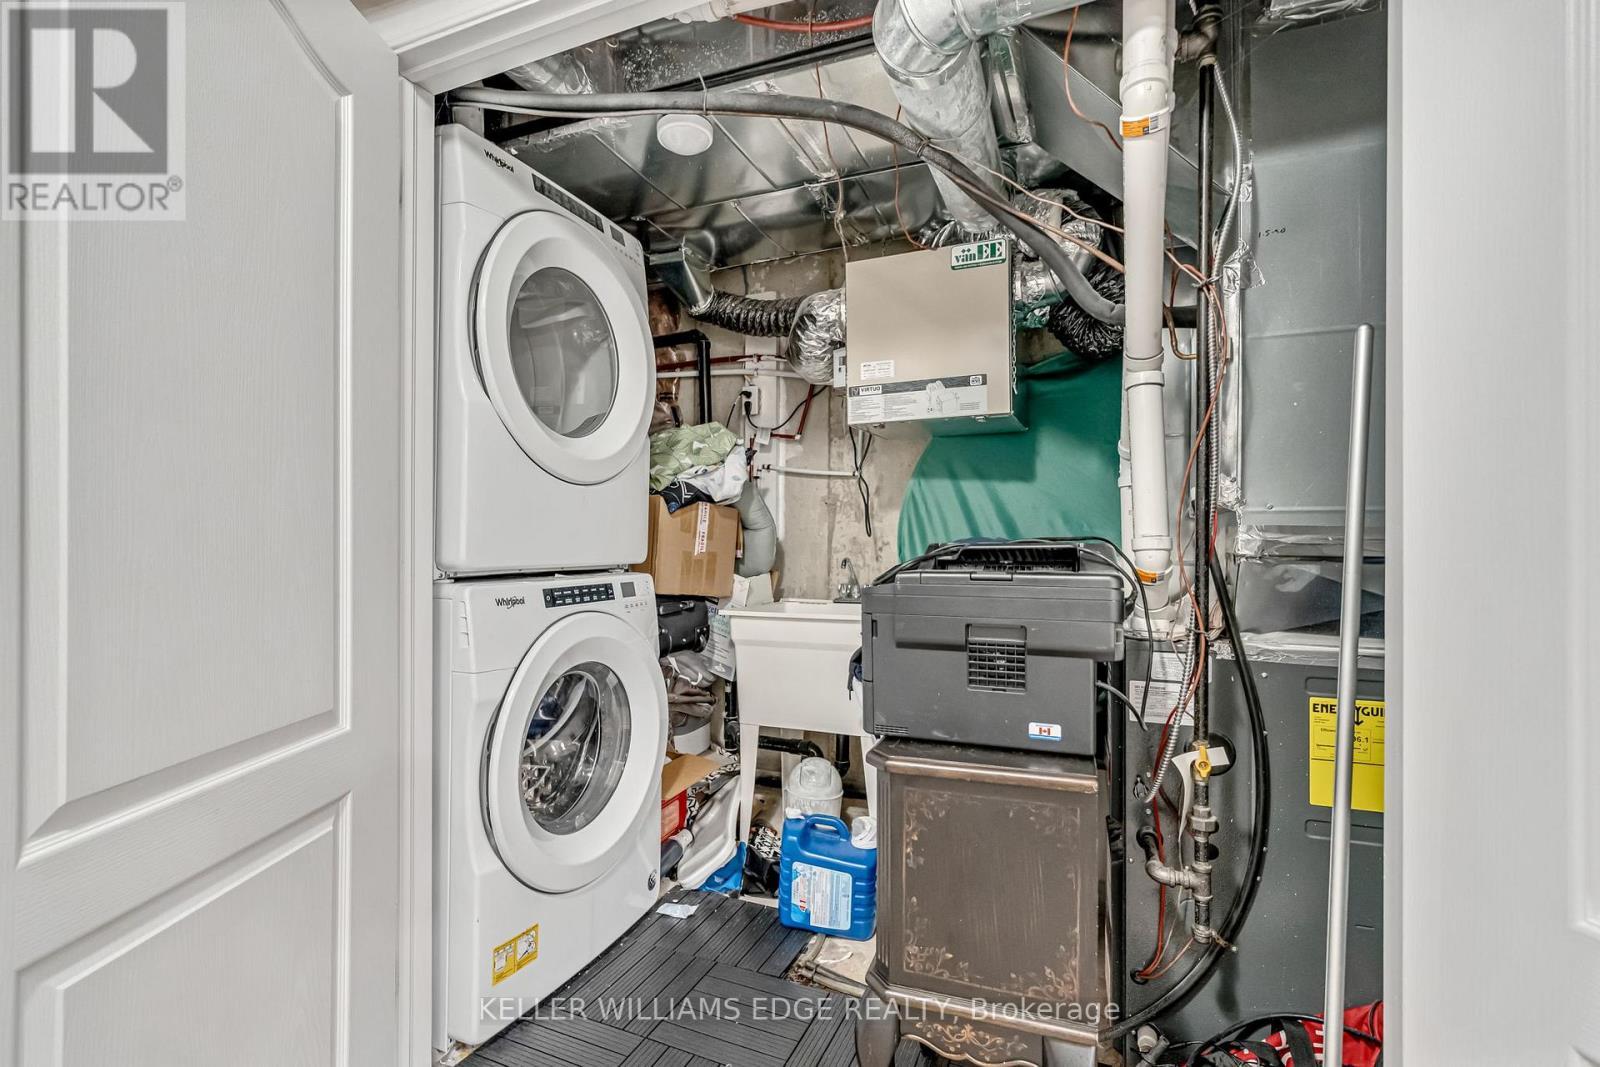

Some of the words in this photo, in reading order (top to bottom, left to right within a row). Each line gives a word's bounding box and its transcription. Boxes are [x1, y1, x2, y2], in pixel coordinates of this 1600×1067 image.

[484, 149, 514, 173] Whirlpool
[861, 386, 881, 394] VIRTUO
[495, 596, 525, 609] Whirlpool
